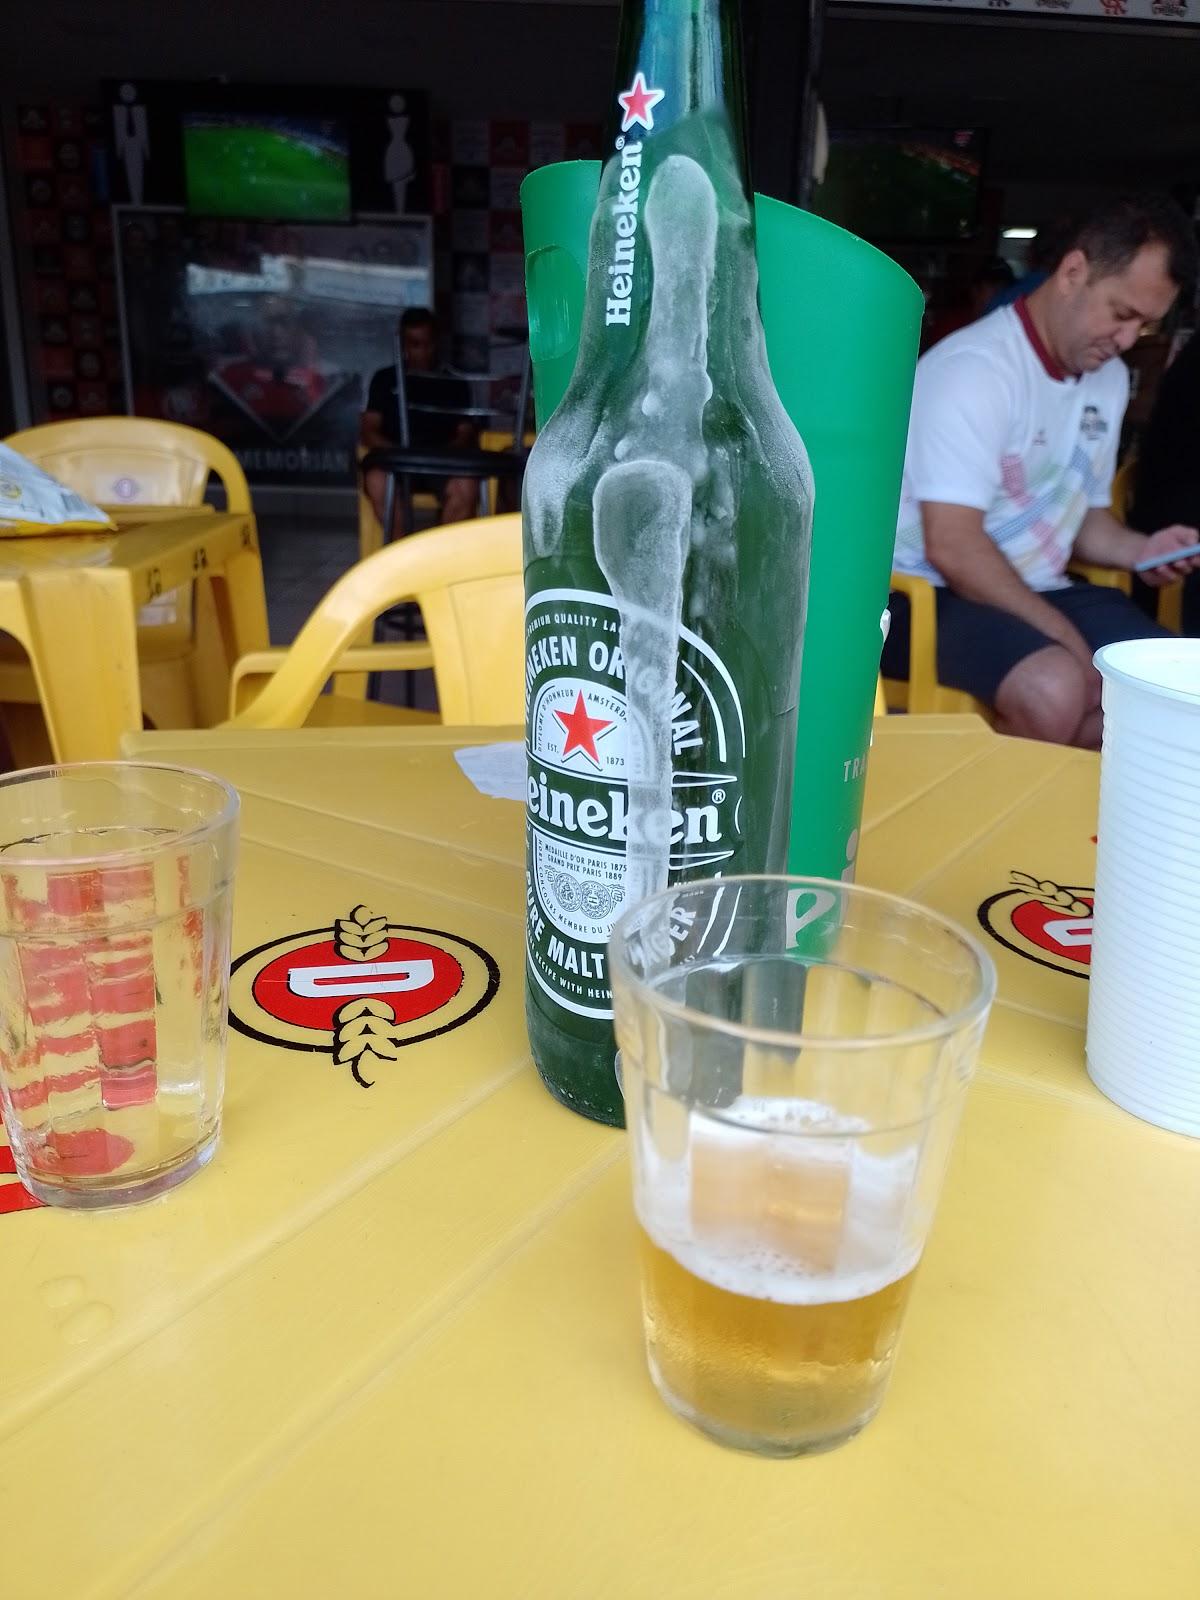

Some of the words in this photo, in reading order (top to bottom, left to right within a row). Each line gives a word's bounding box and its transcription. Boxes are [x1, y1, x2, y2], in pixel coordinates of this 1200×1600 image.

[606, 140, 643, 326] Heineken
[554, 612, 598, 628] QUALITY
[587, 692, 628, 723] AMSTERD
[588, 640, 704, 756] ORIGNAL
[605, 756, 625, 767] 1873
[526, 772, 723, 845] eineken
[544, 842, 569, 860] MEDAILLE
[569, 852, 586, 865] D'OR
[587, 858, 608, 870] PARIS
[610, 862, 628, 873] 1875
[547, 854, 565, 868] GRAND
[566, 861, 581, 873] PRIX
[582, 866, 603, 879] PARIS
[604, 870, 623, 882] 1889
[525, 871, 546, 943] PURE
[546, 935, 605, 981] MALT
[557, 914, 588, 934] MEMBRE
[590, 924, 604, 934] DU
[534, 951, 557, 982] RECIPE
[559, 976, 583, 995] WITH
[587, 987, 613, 1000] HEIN
